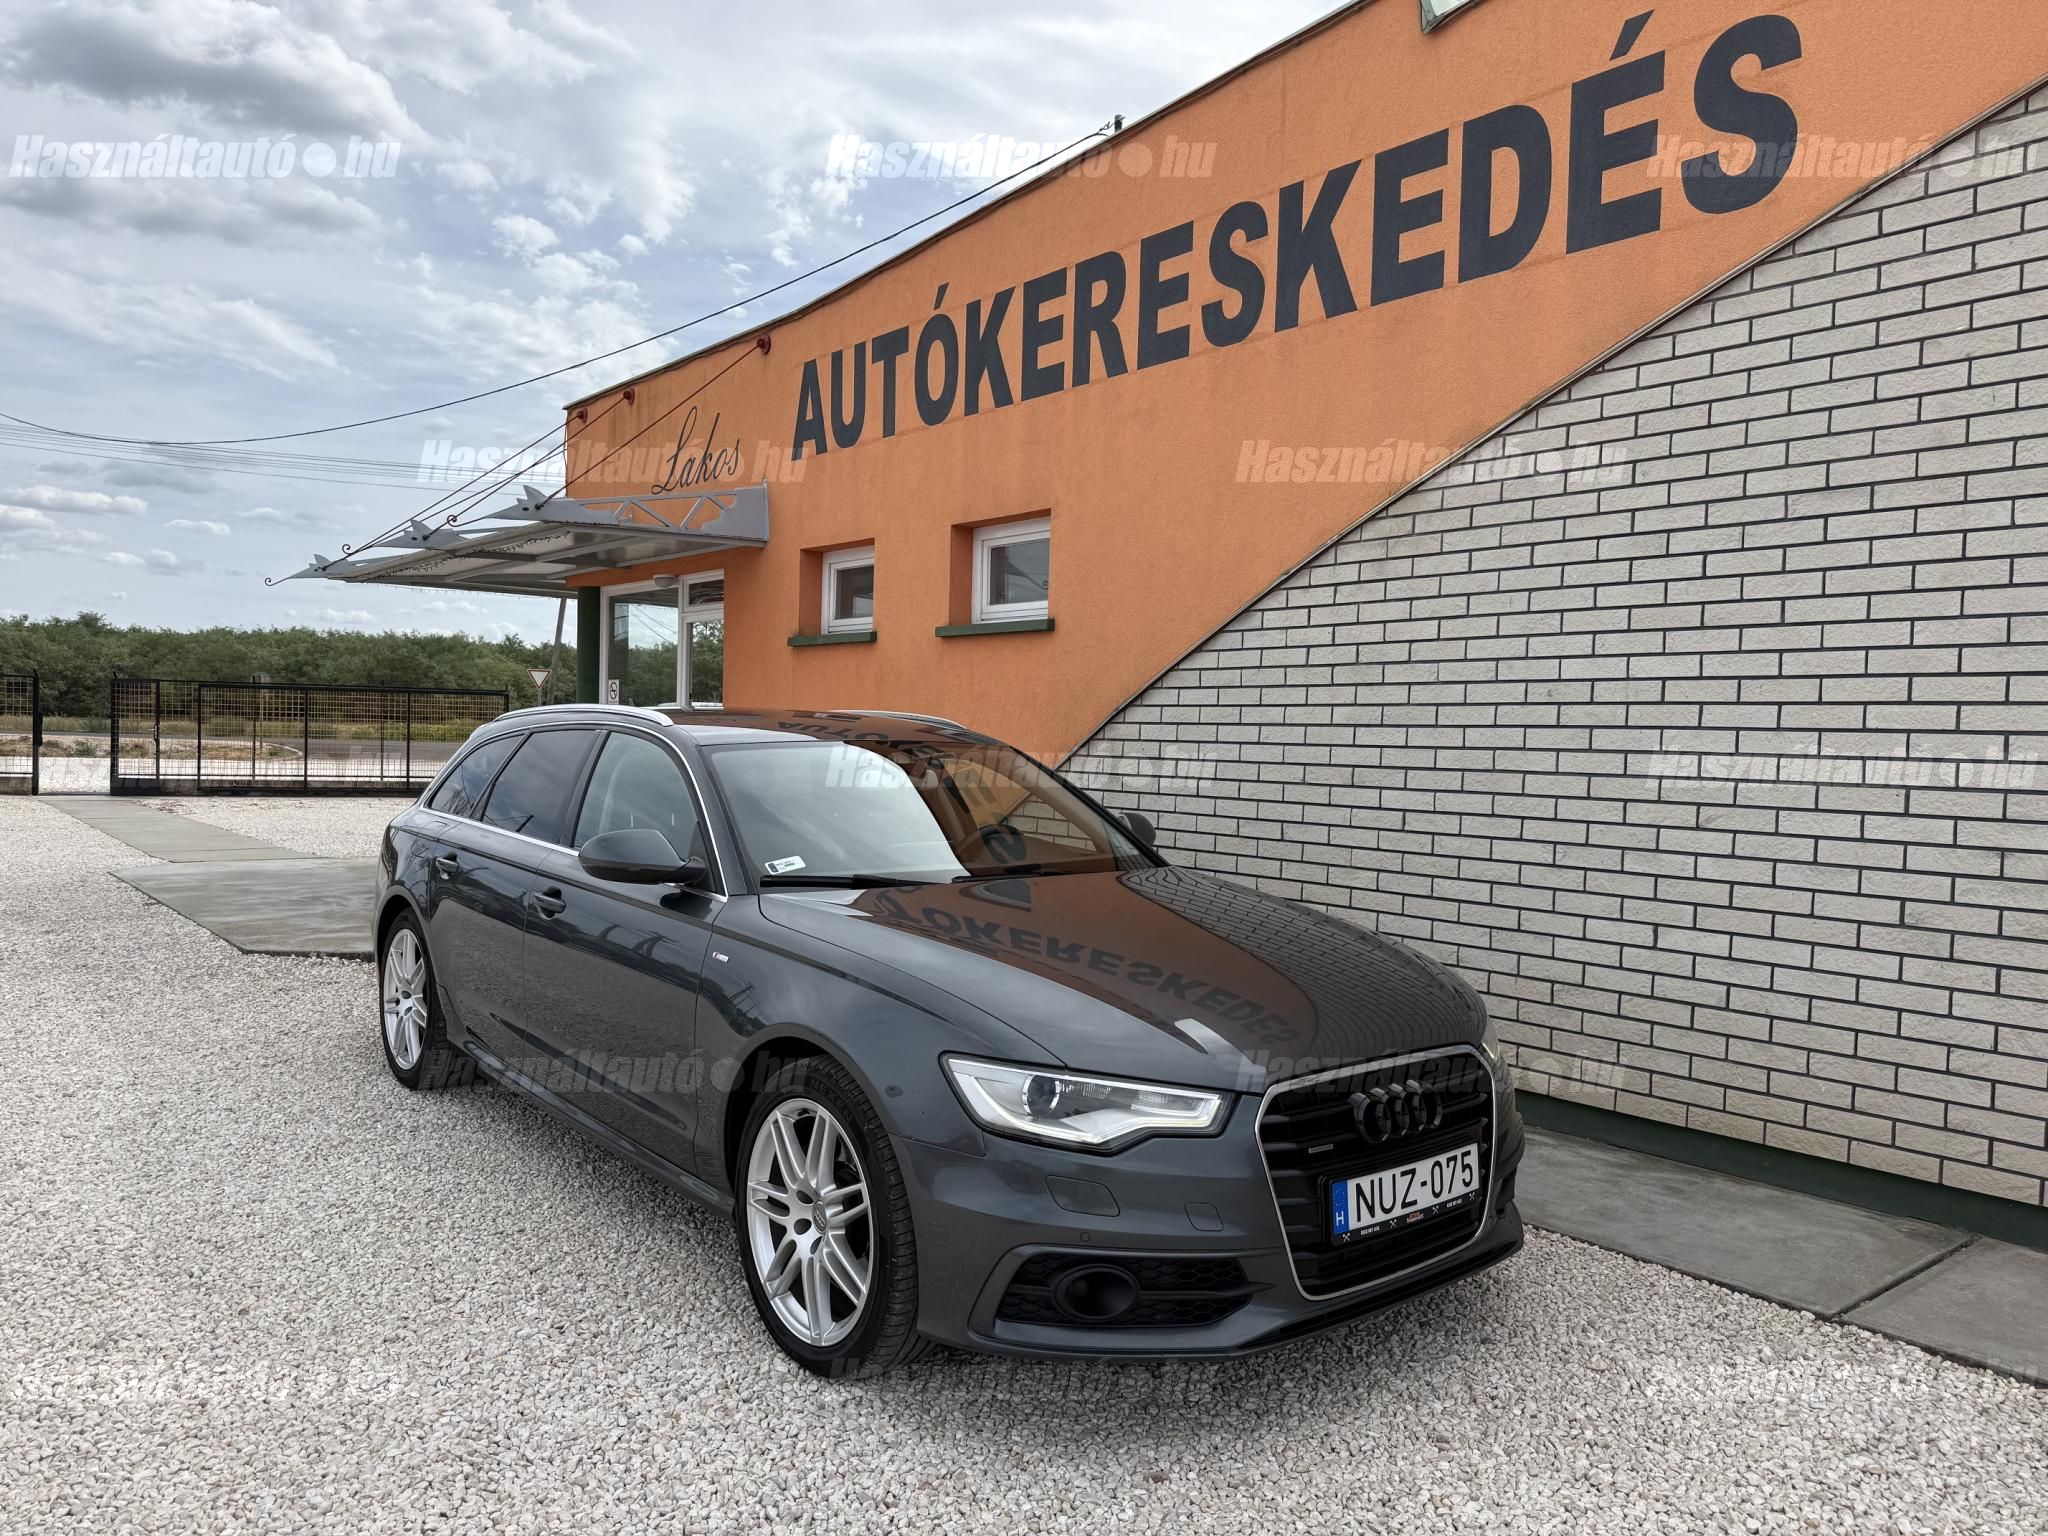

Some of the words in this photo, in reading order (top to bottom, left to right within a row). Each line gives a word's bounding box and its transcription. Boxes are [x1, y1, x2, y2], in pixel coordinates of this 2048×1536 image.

[791, 9, 1802, 461] AUTÓKERESKEDÉS
[651, 406, 740, 494] Lakos
[1335, 1210, 1345, 1226] H
[1356, 1150, 1473, 1222] NUZ-075
